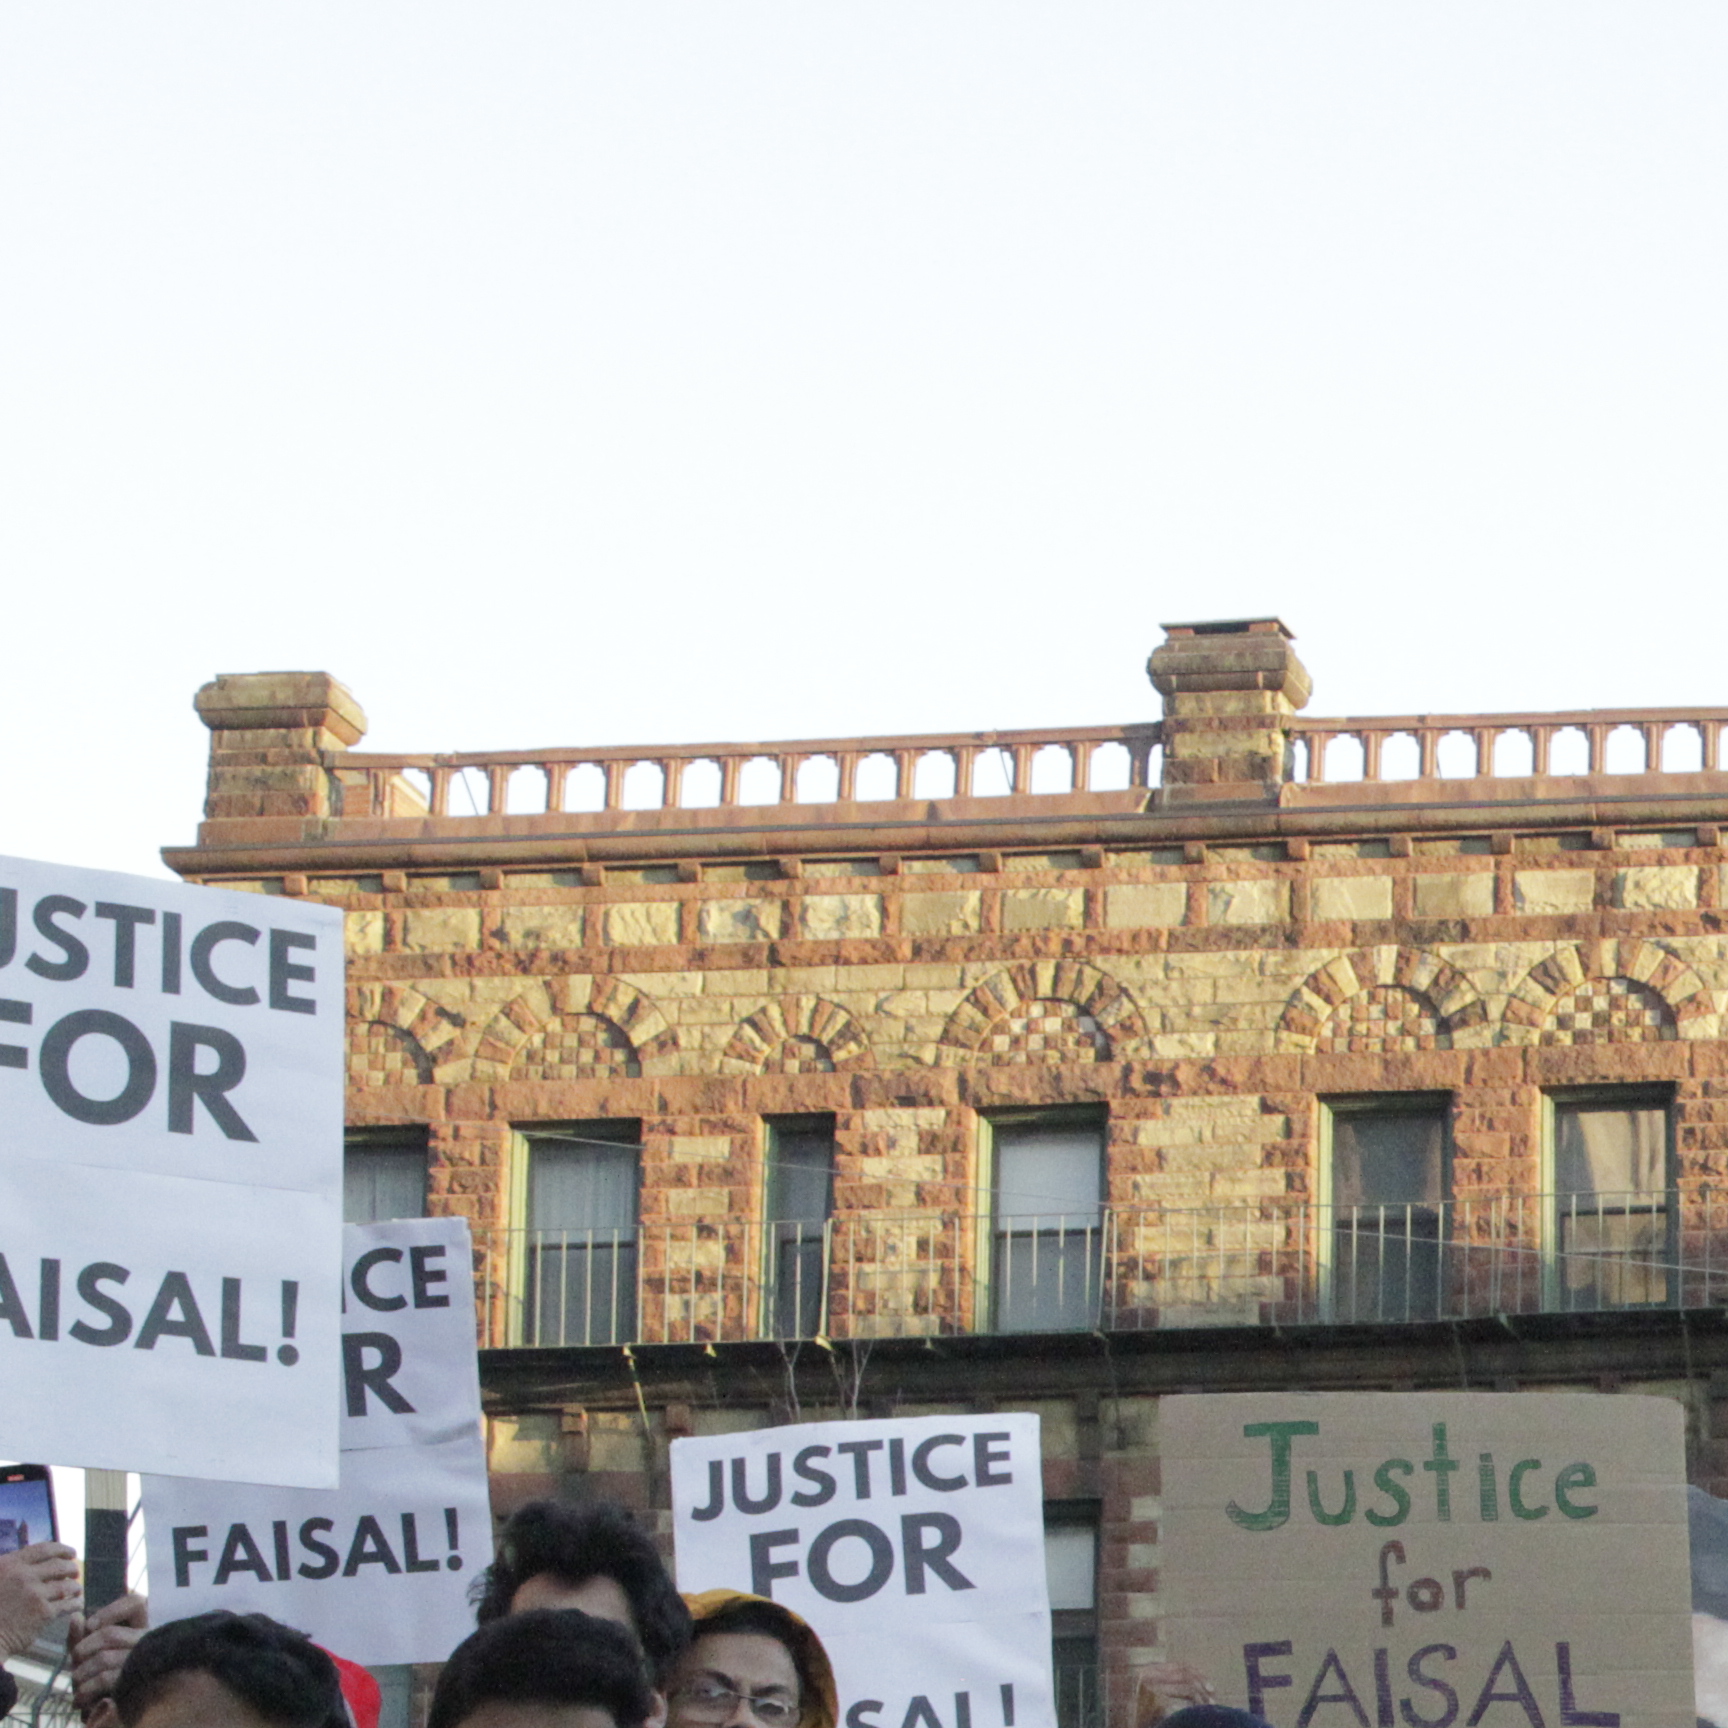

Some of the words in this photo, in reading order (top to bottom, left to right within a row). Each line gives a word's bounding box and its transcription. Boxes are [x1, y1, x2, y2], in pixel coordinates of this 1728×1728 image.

[691, 1432, 1012, 1521] JUSTICE
[1225, 1421, 1598, 1531] Justice
[172, 1507, 463, 1587] FAISAL!
[749, 1512, 977, 1603] FOR
[1372, 1540, 1491, 1627] for
